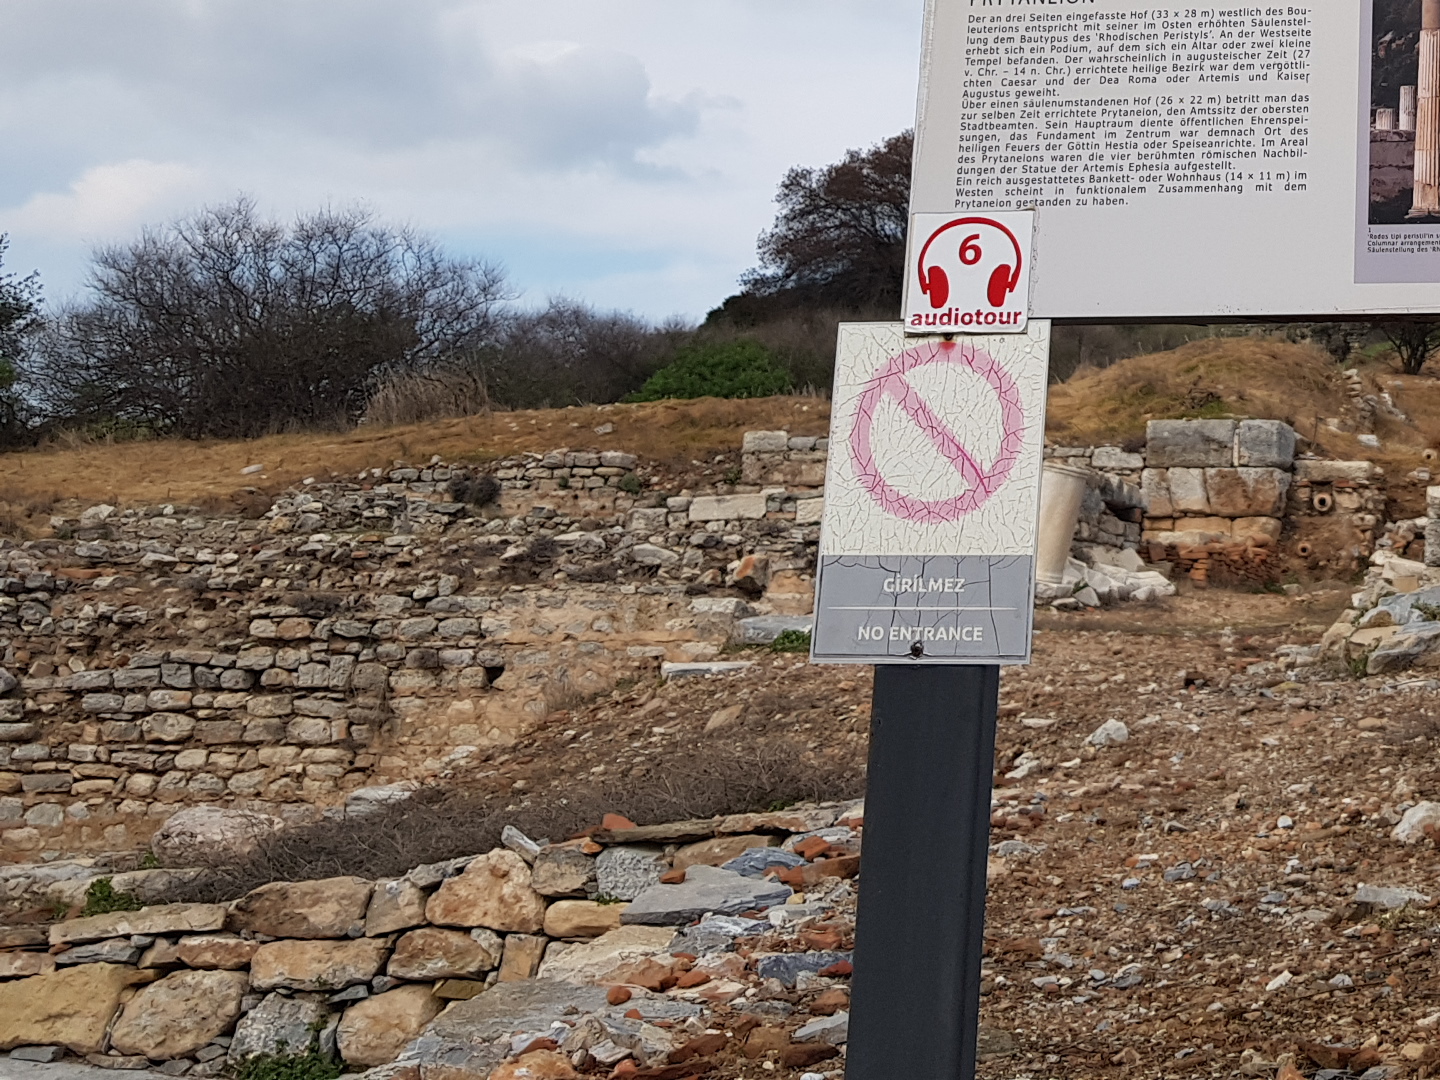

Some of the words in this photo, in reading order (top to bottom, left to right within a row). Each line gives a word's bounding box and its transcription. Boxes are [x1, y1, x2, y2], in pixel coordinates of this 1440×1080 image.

[968, 25, 1019, 34] leuterions
[1025, 23, 1078, 33] entspricht
[1084, 23, 1100, 31] mit
[1106, 22, 1138, 31] seiner
[1144, 22, 1156, 30] im
[1162, 21, 1192, 29] Osten
[1198, 20, 1245, 28] erhöhten
[967, 36, 988, 45] lung
[993, 36, 1015, 44] dem
[1020, 35, 1068, 44] Bautypus
[1073, 34, 1091, 42] des
[1238, 30, 1255, 38] der
[1260, 29, 1311, 38] Westseite
[957, 166, 995, 175] dungen
[1000, 165, 1017, 174] der
[1022, 165, 1057, 174] Statue
[1061, 164, 1079, 173] der
[1083, 164, 1124, 172] Artemis
[1129, 163, 1169, 173] Ephesia
[955, 199, 1011, 209] Prytaneion
[1016, 198, 1071, 208] gestanden
[959, 234, 982, 265] 6
[910, 309, 1022, 326] audiotour
[884, 574, 965, 593] GİRİLMEZ
[858, 627, 884, 640] NO
[889, 626, 982, 641] ENTRANCE
